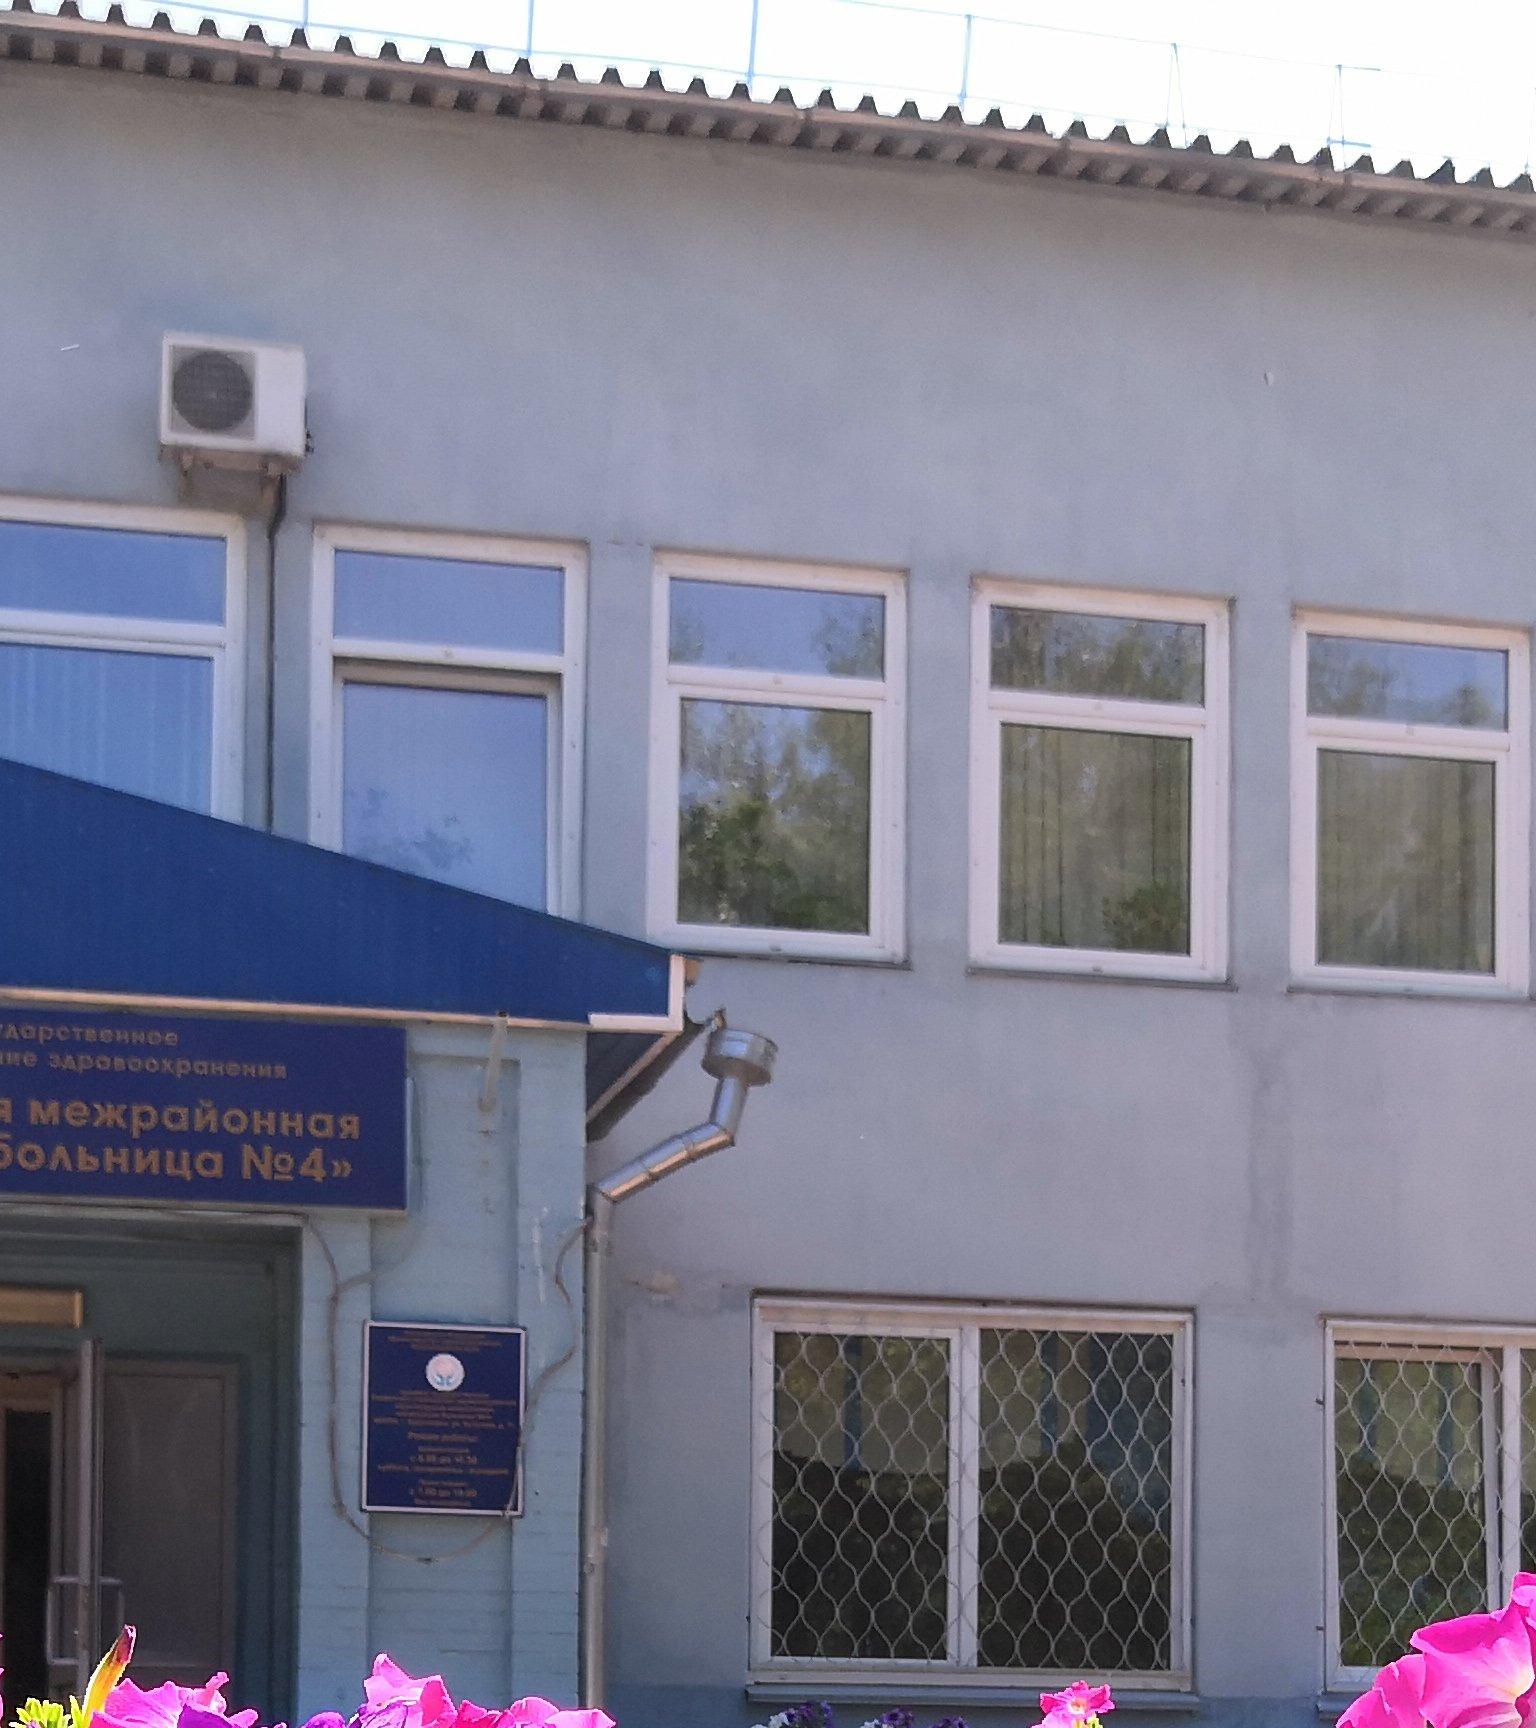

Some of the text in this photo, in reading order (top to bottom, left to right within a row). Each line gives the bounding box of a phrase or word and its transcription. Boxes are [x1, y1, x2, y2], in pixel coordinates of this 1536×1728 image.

[49, 1052, 287, 1079] здравоохранения
[29, 1097, 360, 1139] межрайонная
[240, 1143, 353, 1182] №4»
